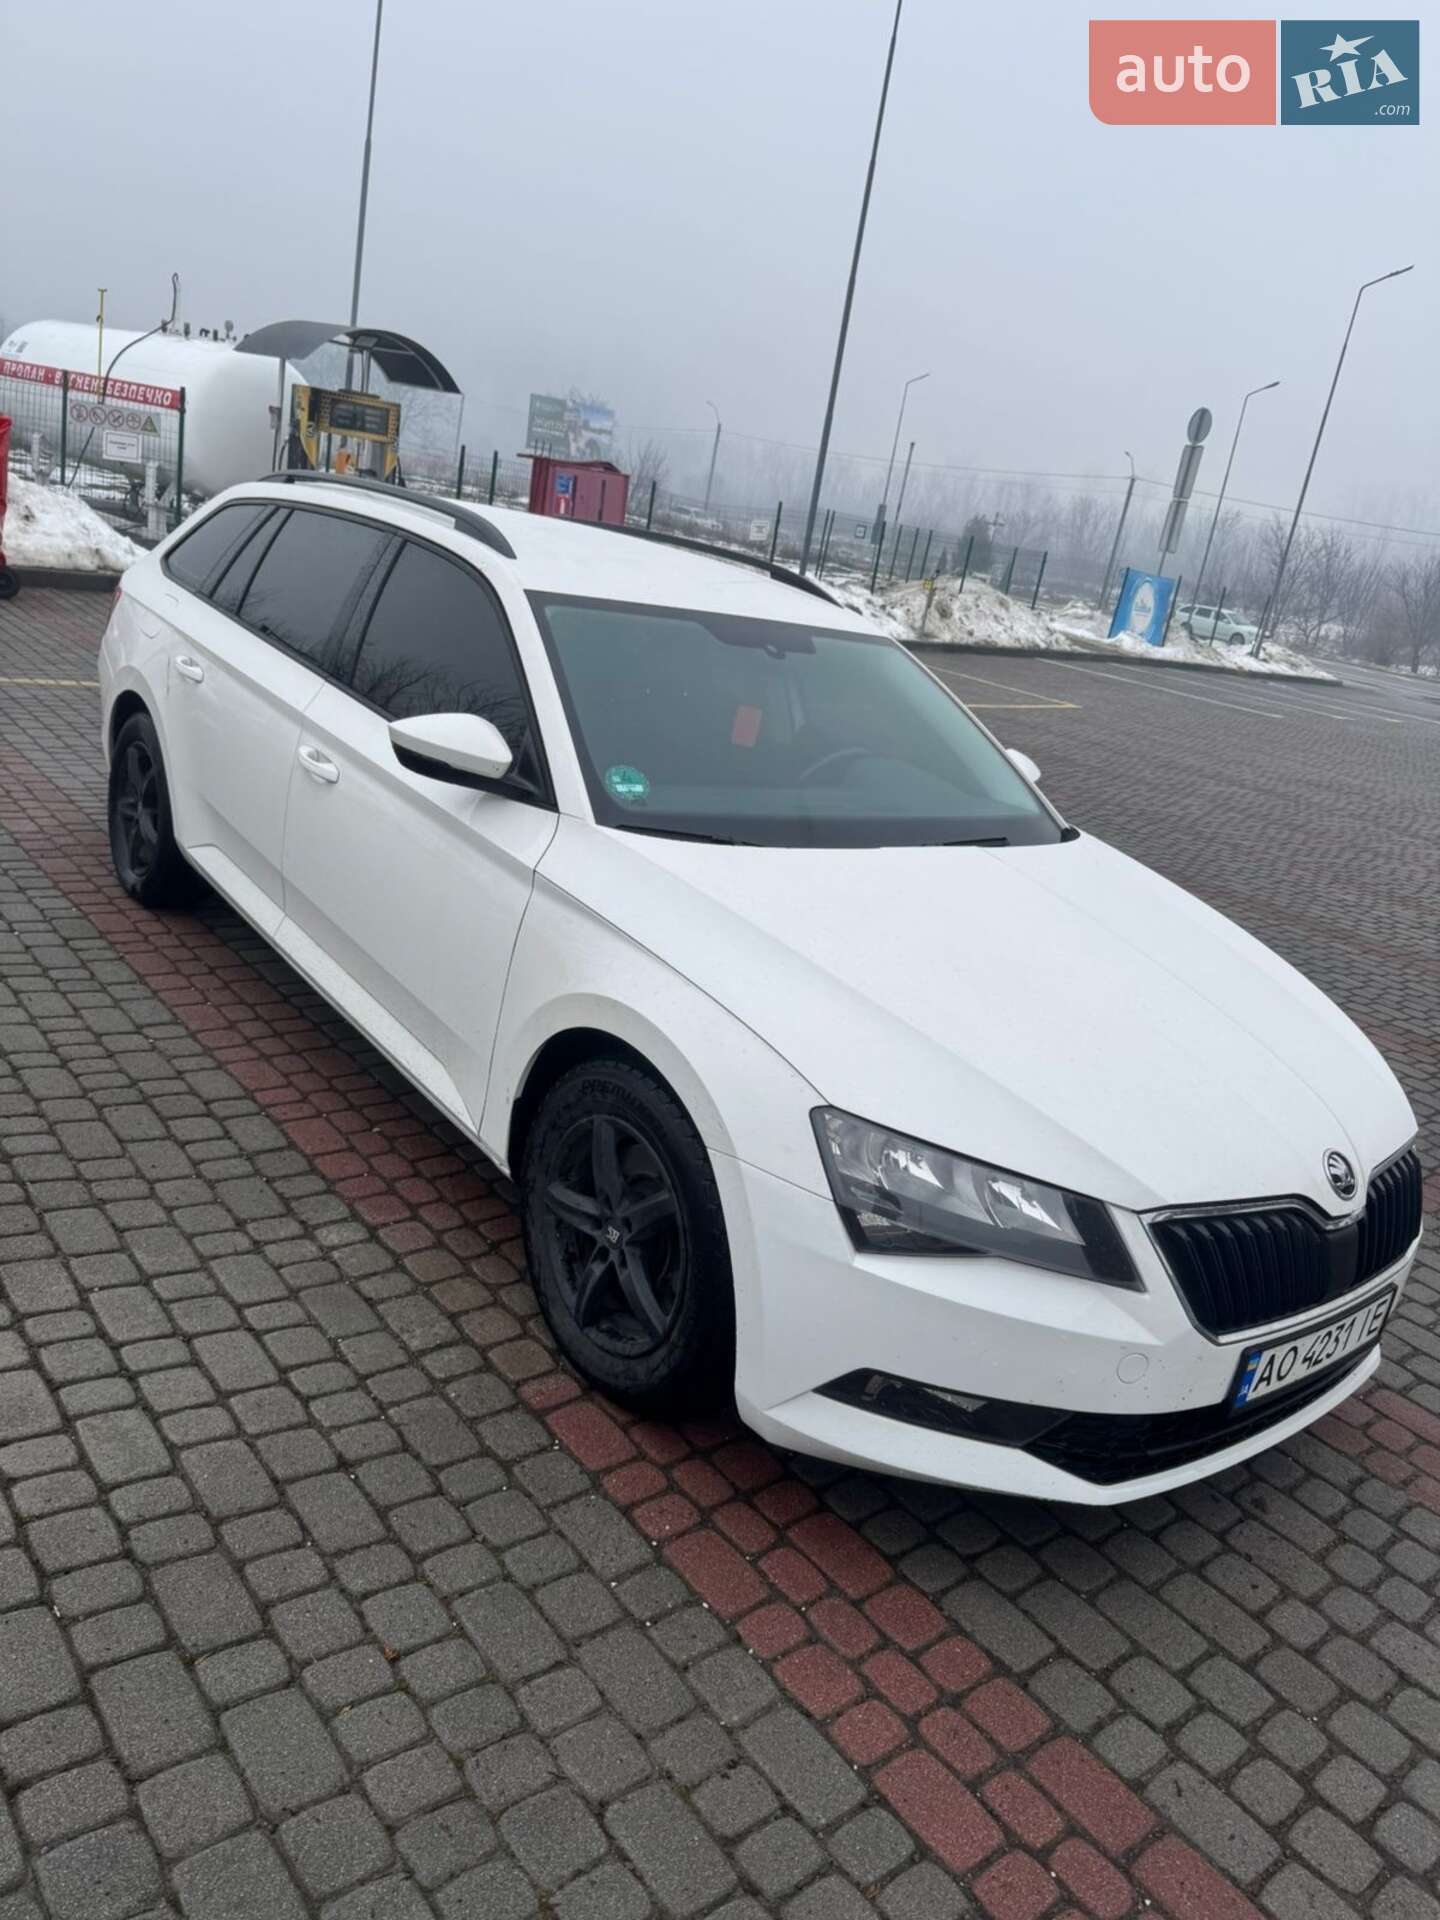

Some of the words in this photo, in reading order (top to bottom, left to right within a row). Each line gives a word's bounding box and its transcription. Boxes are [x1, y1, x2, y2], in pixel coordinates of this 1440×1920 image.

[3, 361, 46, 382] ПРОПАН
[54, 371, 173, 406] ВГНЕНЕБЕЗПЕЧНО
[1252, 1346, 1299, 1392] AO
[1302, 1317, 1357, 1370] 4231
[1357, 1299, 1388, 1341] IE
